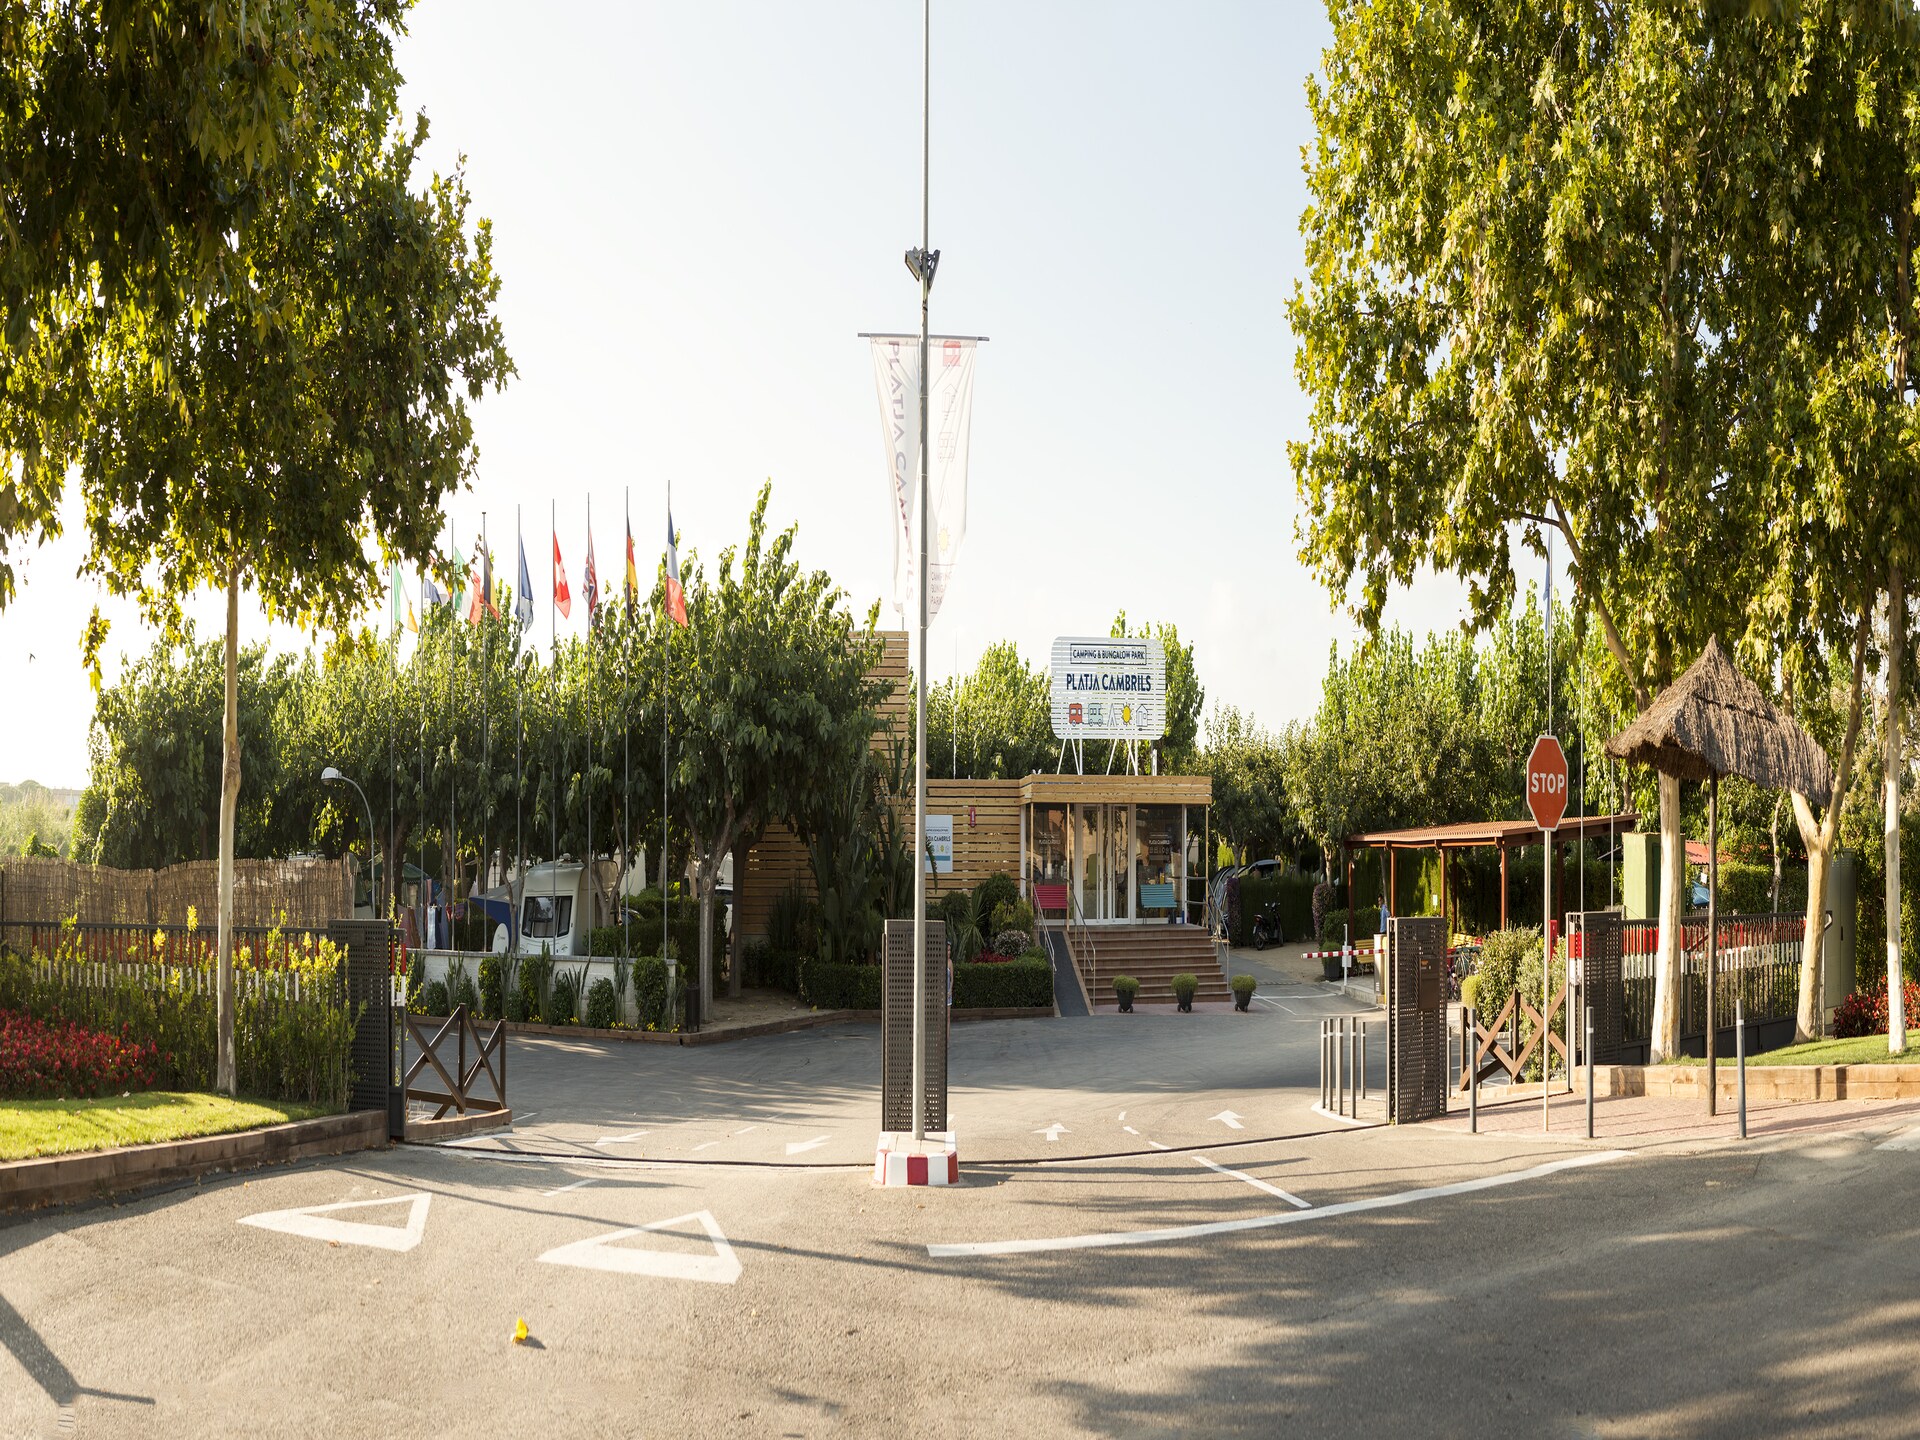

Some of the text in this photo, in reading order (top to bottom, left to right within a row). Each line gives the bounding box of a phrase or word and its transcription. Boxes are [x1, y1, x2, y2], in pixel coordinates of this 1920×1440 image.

[888, 340, 905, 443] PLATJA
[1072, 649, 1145, 660] CAMPING & BUNGALOW PARK
[1066, 673, 1152, 692] PLATJA CAMBRILS
[1531, 772, 1565, 794] STOP
